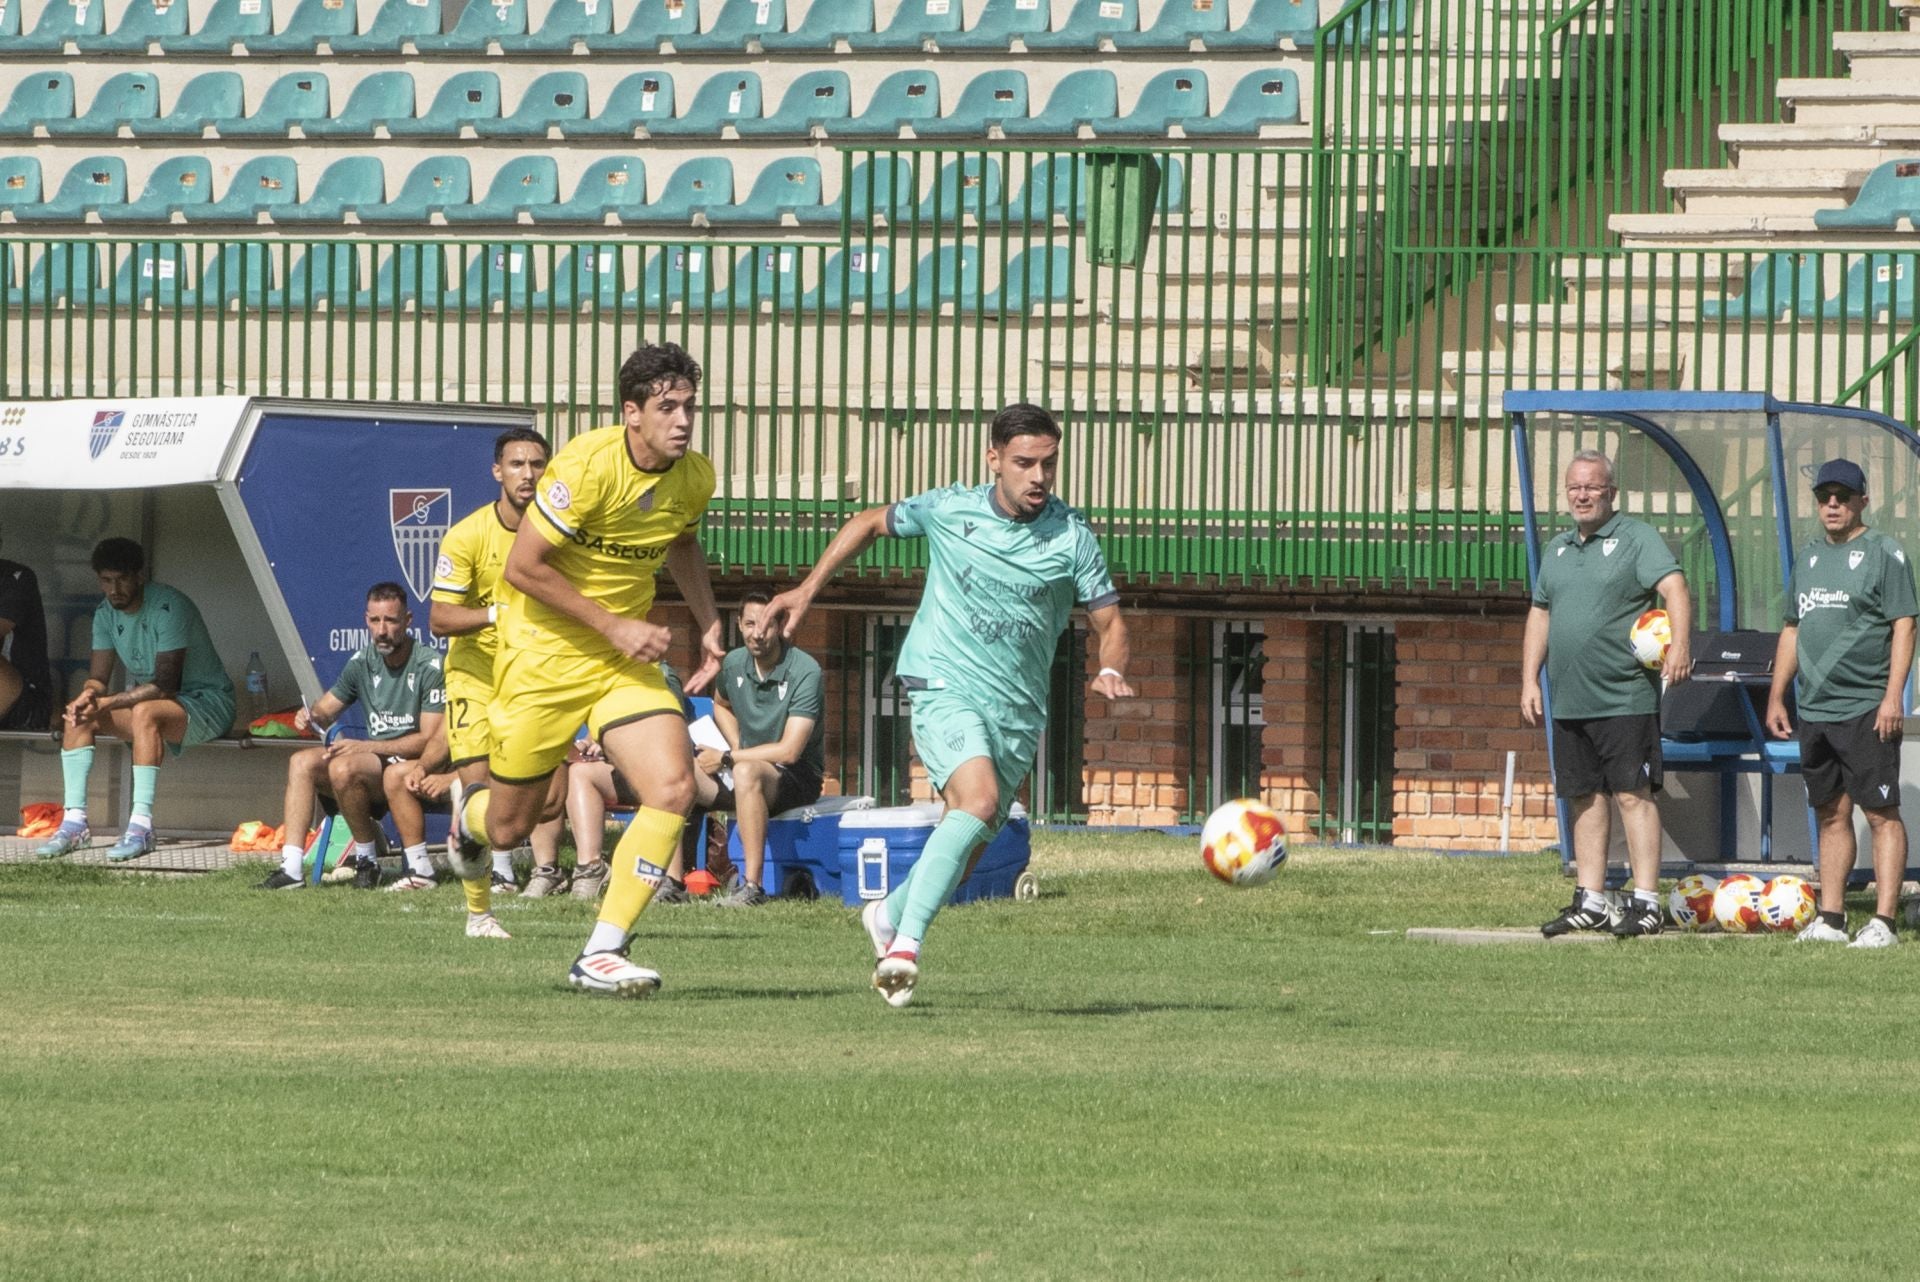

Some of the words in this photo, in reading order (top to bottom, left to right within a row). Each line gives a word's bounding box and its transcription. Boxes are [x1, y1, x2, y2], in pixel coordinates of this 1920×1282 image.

[132, 410, 197, 428] GIMNÁSTICA
[125, 432, 184, 446] SEGOVIANA
[1809, 590, 1849, 604] Magullo
[448, 697, 469, 730] 12
